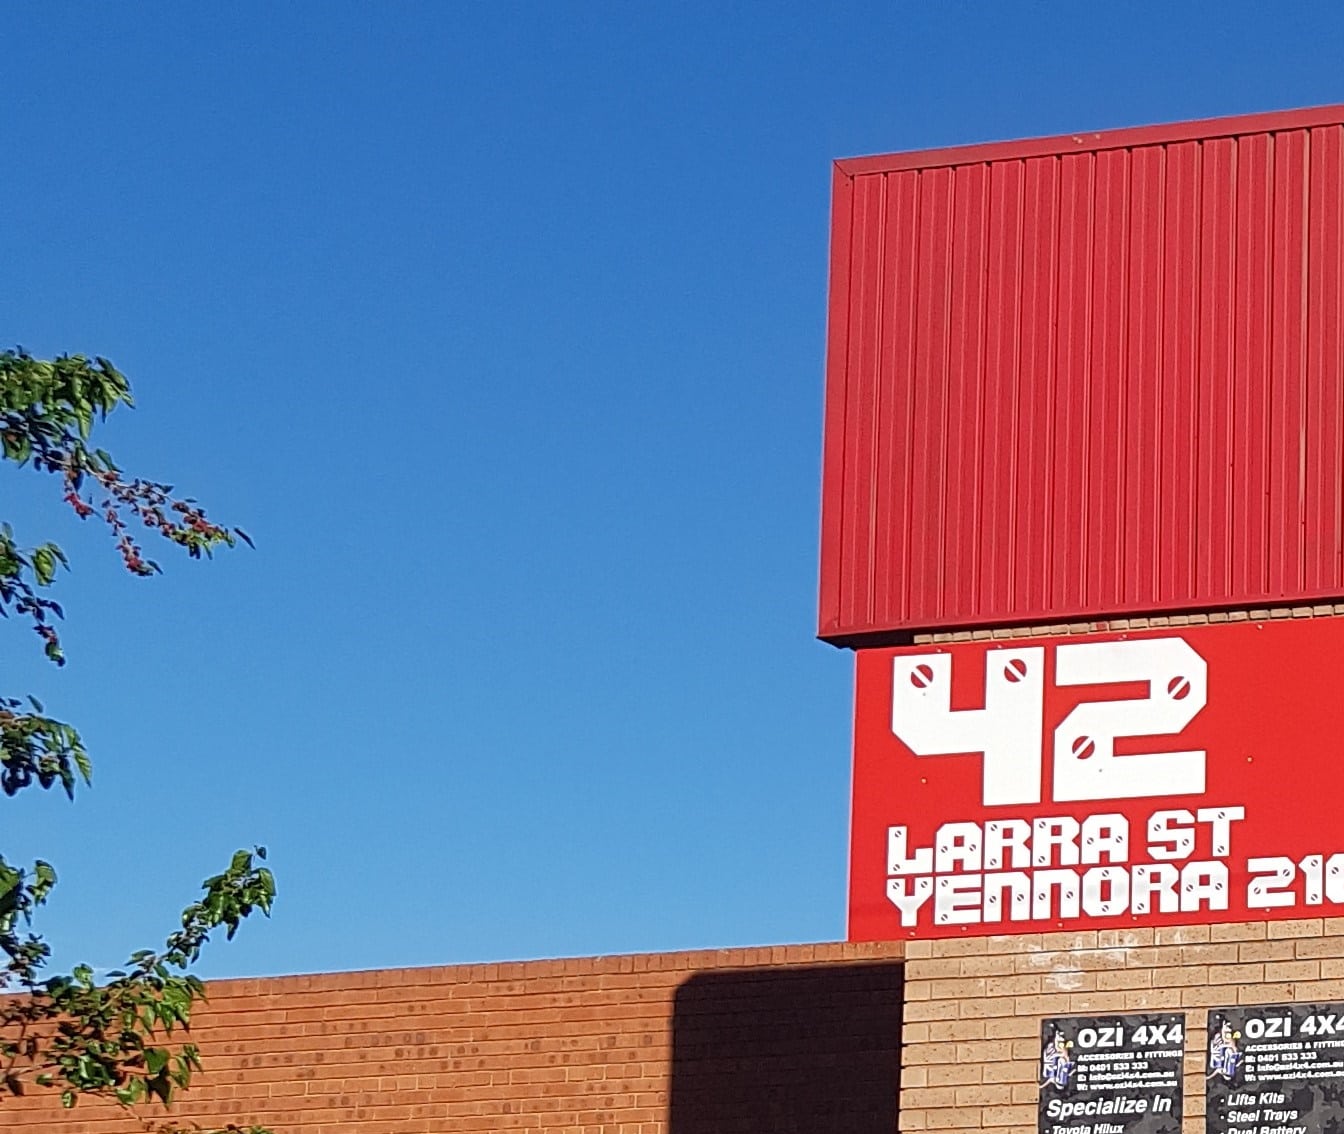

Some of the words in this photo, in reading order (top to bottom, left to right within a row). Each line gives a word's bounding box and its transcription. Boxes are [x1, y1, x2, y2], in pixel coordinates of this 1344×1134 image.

[892, 637, 1208, 806] 42
[888, 814, 1129, 874] LARRA
[1147, 806, 1245, 858] ST
[886, 860, 1228, 927] YENNORA
[1131, 1023, 1183, 1045] 4X4
[1046, 1097, 1147, 1120] Specialize
[1152, 1094, 1172, 1112] In
[1227, 1094, 1256, 1106] Lifts
[1259, 1092, 1285, 1105] Kits
[1227, 1110, 1260, 1123] Steel
[1263, 1109, 1298, 1123] Trays
[1094, 1123, 1124, 1134] Hilux
